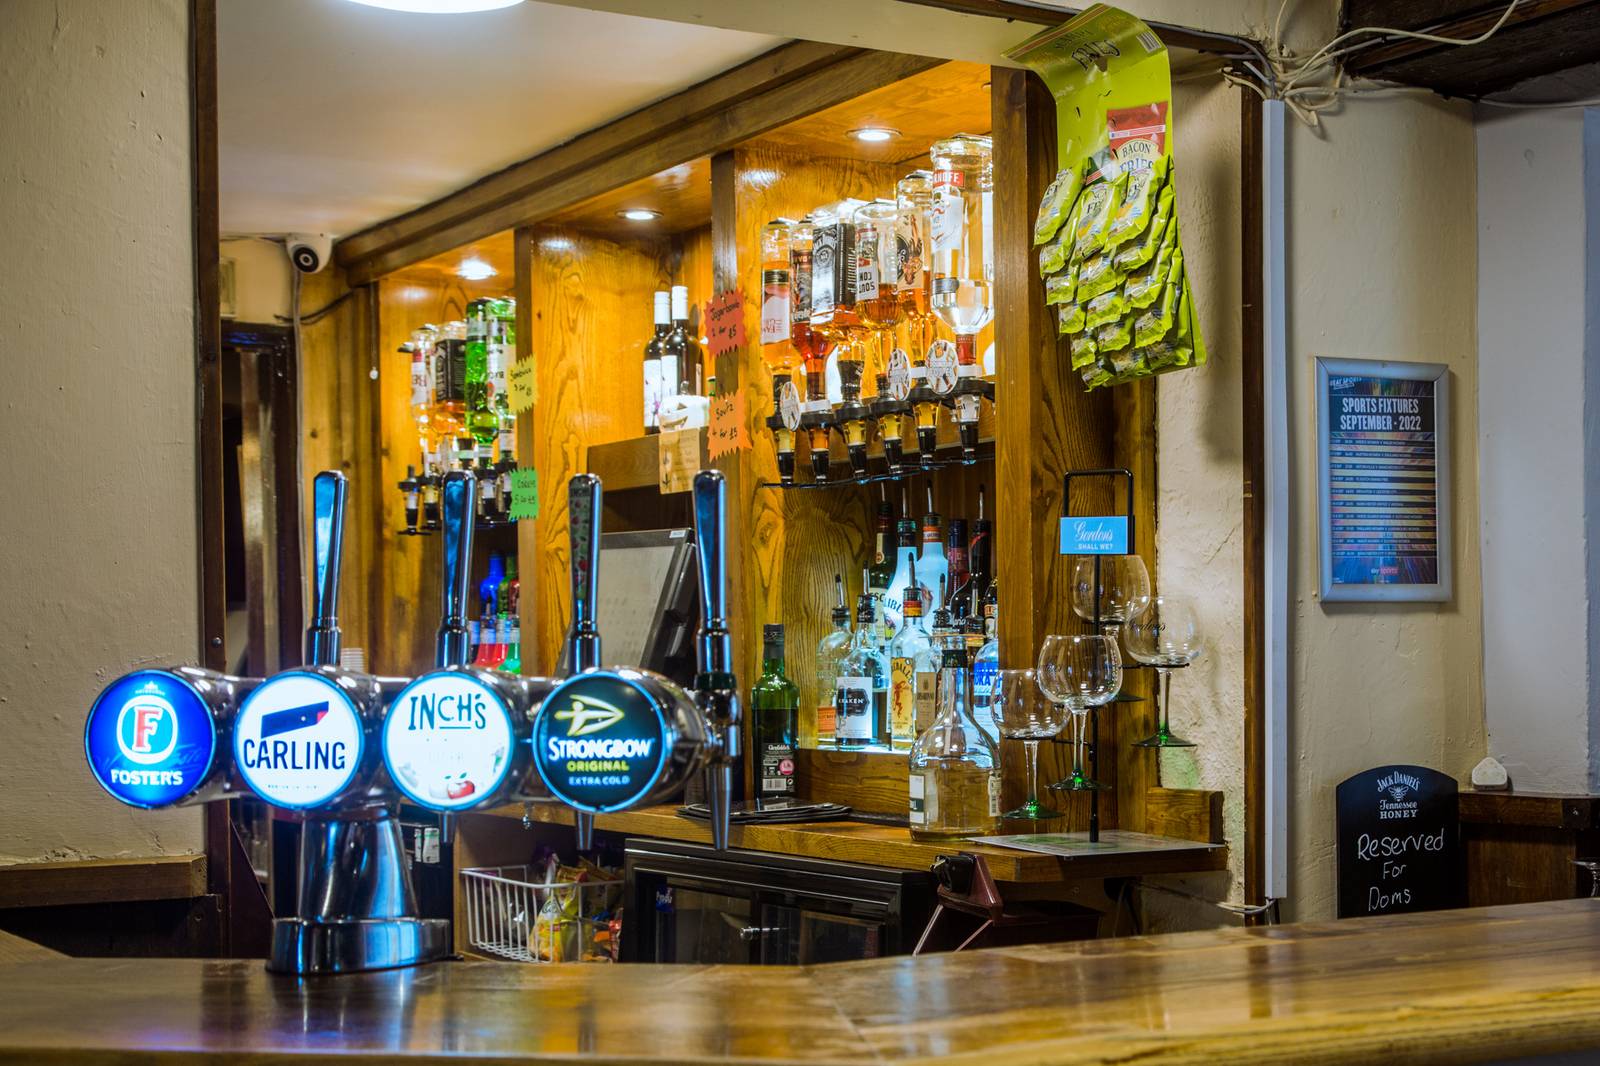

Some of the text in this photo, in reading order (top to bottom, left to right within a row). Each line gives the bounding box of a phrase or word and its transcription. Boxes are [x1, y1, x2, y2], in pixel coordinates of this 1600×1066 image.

[1121, 141, 1151, 158] BACON
[1342, 397, 1419, 414] SPORTS FIXTURES
[1340, 415, 1421, 431] SEPTEMBER 2022
[243, 739, 346, 770] CARLING
[548, 736, 650, 760] STRONGBOW
[567, 760, 630, 772] ORIGINAL
[110, 769, 184, 786] FOSTER'S
[569, 775, 630, 786] EXTRA COLD
[1377, 771, 1420, 792] JACK DANIEL'S
[1380, 799, 1418, 810] Tennessee
[1380, 809, 1418, 820] HONEY
[1357, 828, 1444, 861] Reserved
[1382, 860, 1406, 879] For
[1368, 886, 1411, 911] Doms
